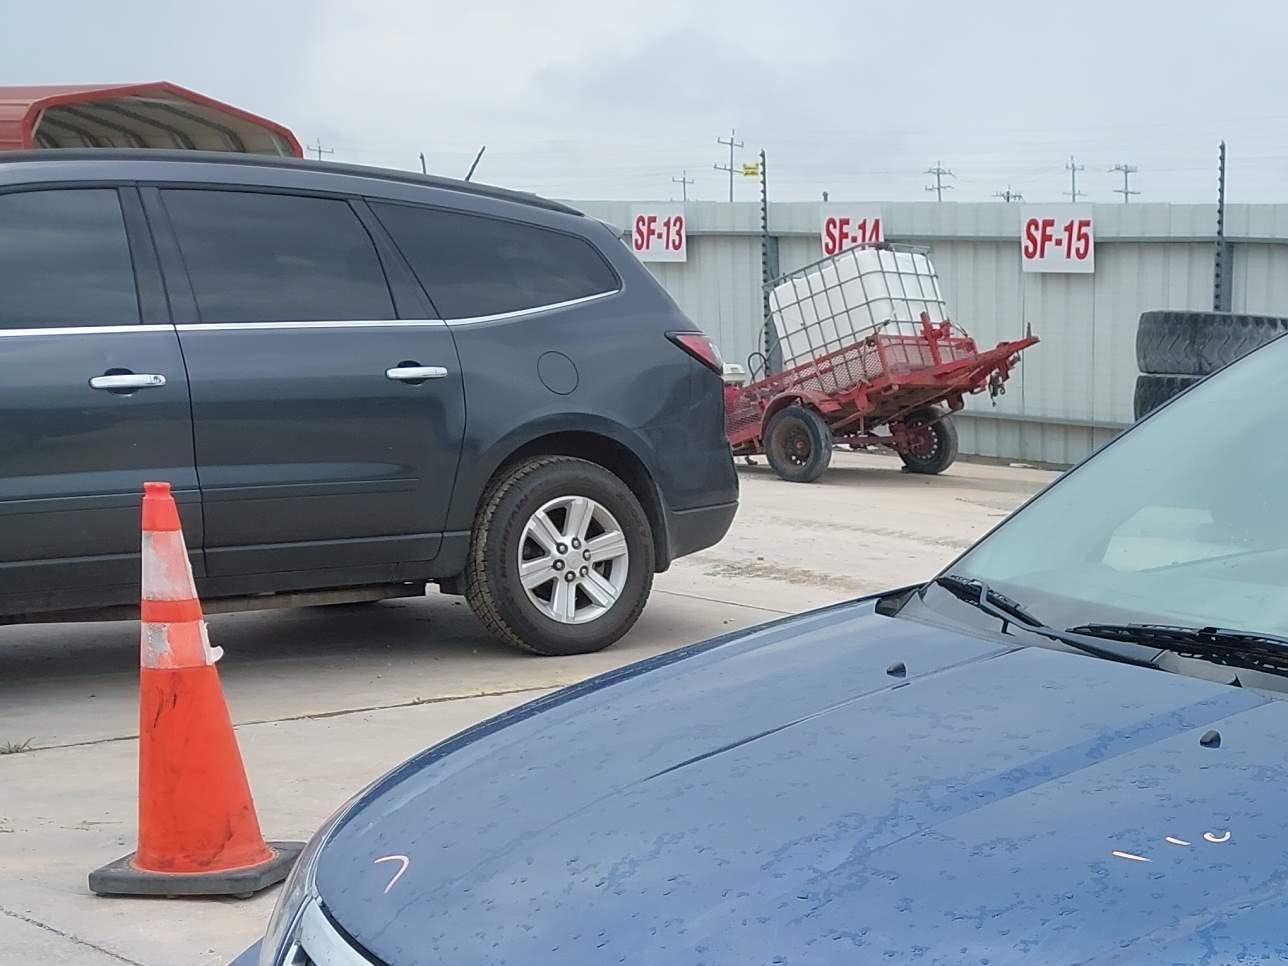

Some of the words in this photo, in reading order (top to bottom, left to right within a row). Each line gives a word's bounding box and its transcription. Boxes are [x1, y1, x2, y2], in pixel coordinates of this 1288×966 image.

[634, 215, 684, 251] SF-13
[825, 217, 880, 255] SF-14
[1023, 218, 1091, 260] SF-15
